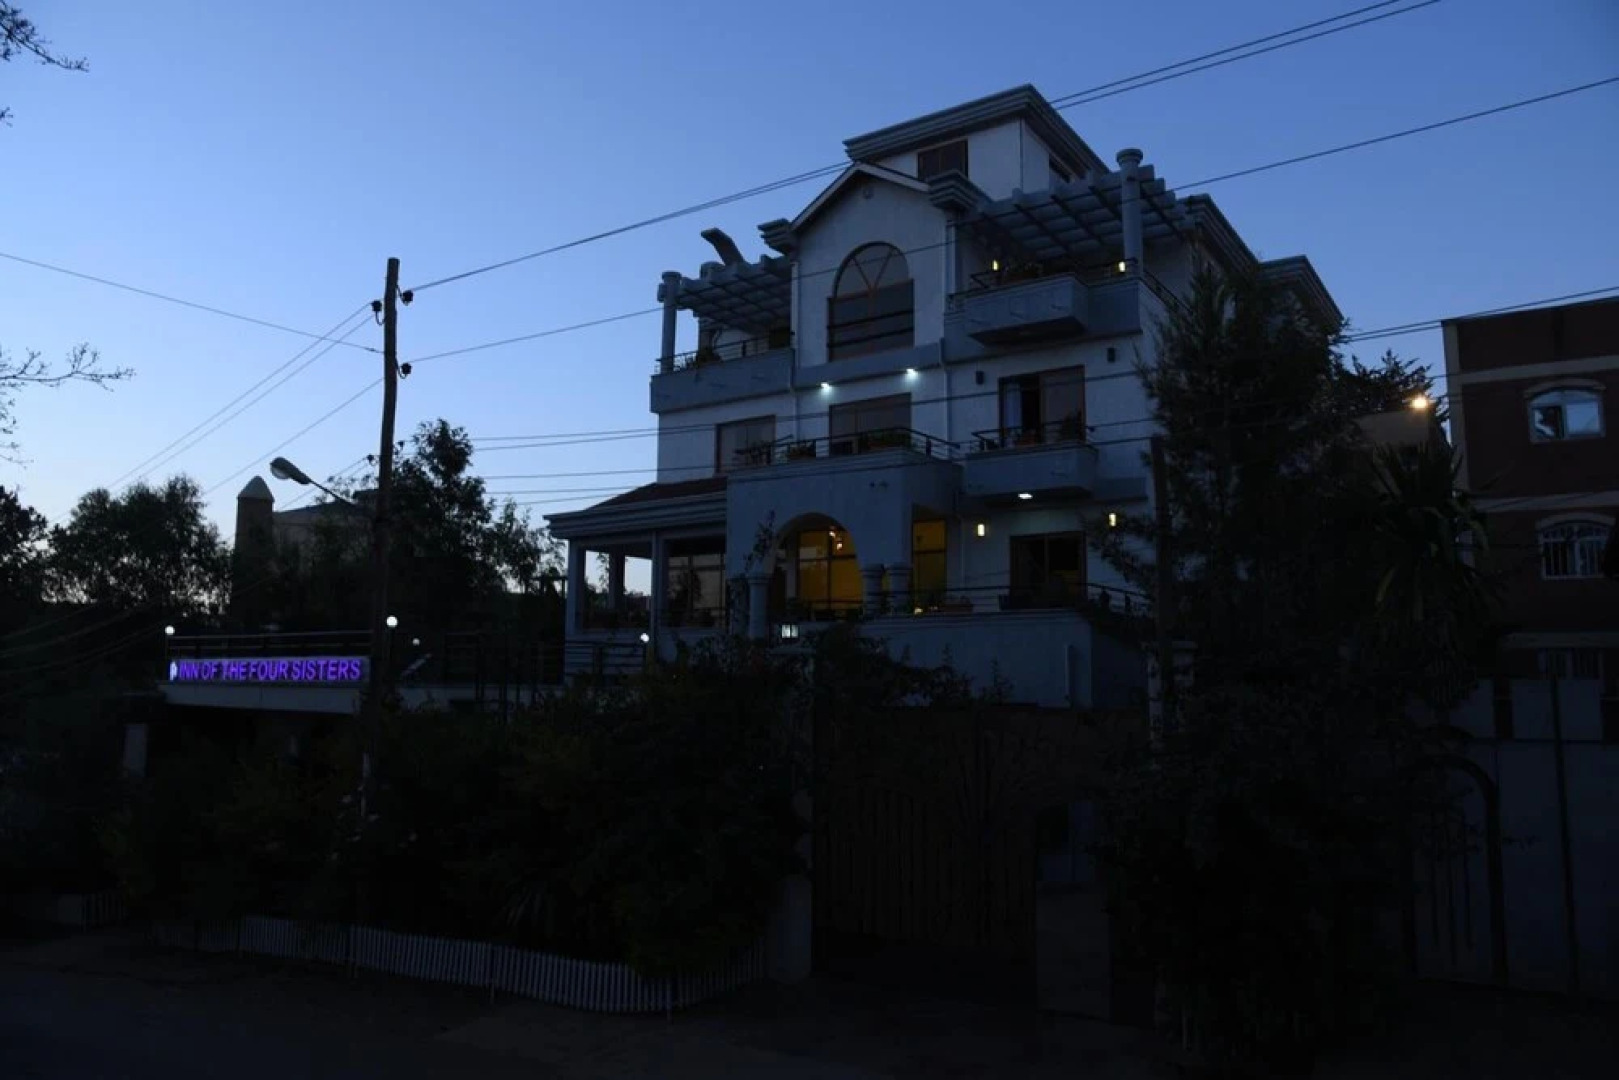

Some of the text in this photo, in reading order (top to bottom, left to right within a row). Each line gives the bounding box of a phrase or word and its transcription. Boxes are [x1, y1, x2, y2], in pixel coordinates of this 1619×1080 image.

[201, 661, 218, 680] OF
[221, 661, 247, 680] THE
[249, 660, 289, 680] FOUR
[290, 659, 361, 680] SISTERS
